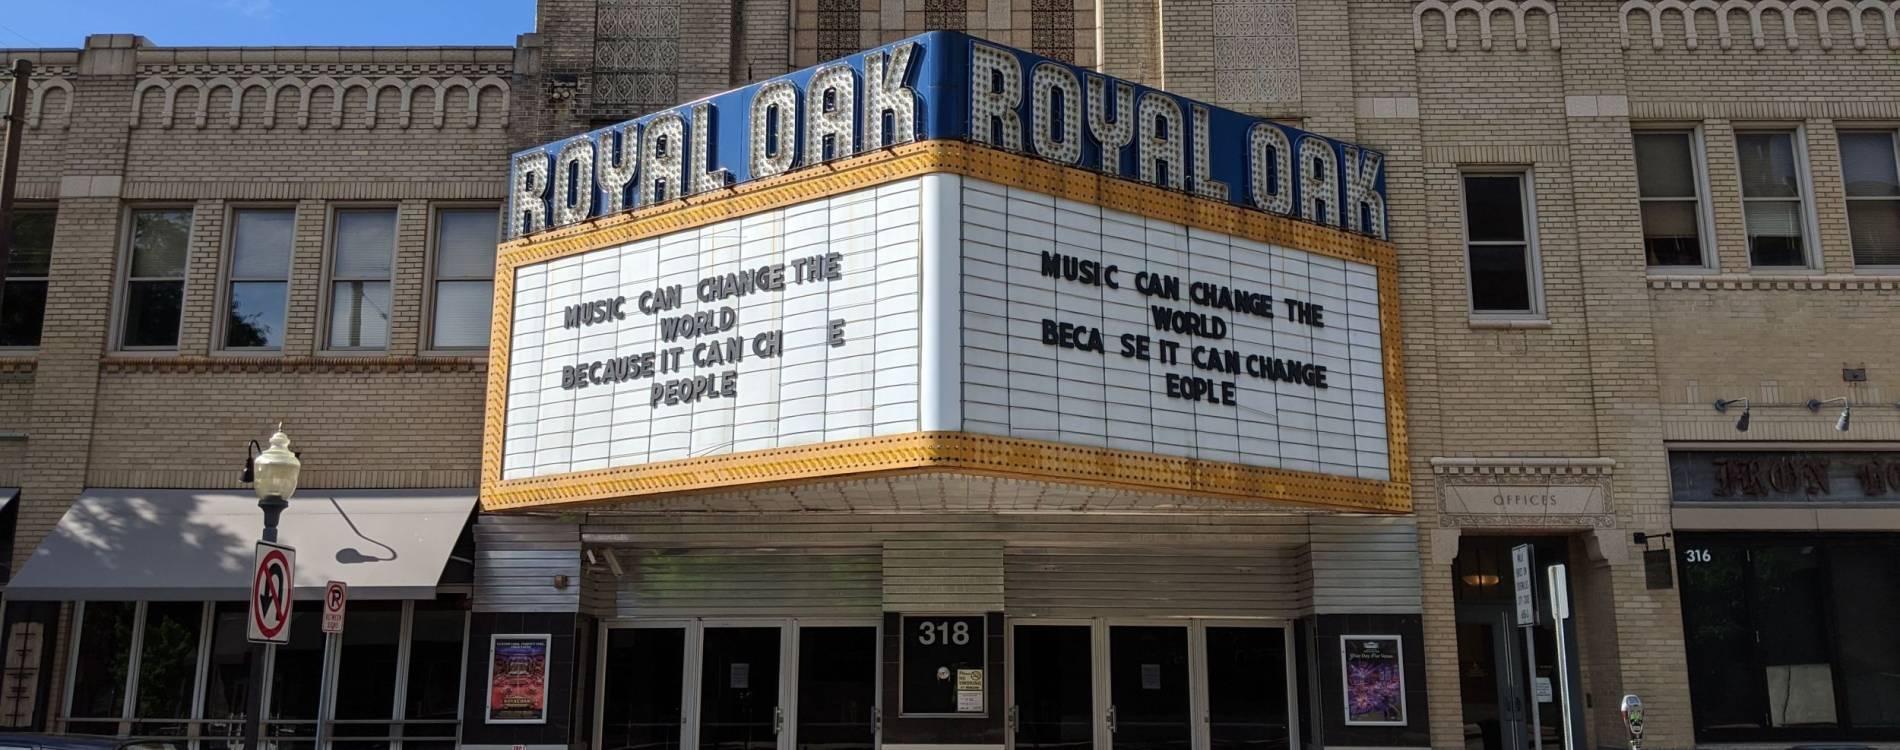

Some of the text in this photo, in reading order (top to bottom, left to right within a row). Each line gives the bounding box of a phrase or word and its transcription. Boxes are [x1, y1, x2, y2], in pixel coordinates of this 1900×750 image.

[510, 41, 926, 239] ROYAL OAK
[969, 40, 1387, 241] ROYAL OAK
[564, 252, 843, 329] MUSIC CAN CHANGE THE
[1041, 250, 1325, 328] MUSIC CAN CHANGE THE
[660, 306, 736, 342] WORLD
[1151, 305, 1227, 340] WORLD
[561, 351, 655, 389] BECAUSE
[660, 347, 685, 374] IT
[692, 335, 743, 367] CAN
[1159, 339, 1180, 365] IT
[1191, 345, 1241, 375] CAN
[1246, 354, 1328, 389] CHANGE
[650, 370, 737, 408] PEOPLE
[1166, 373, 1236, 406] EOPLE
[1493, 494, 1557, 506] OFFICES
[1686, 549, 1711, 562] 316
[918, 621, 970, 645] 318
